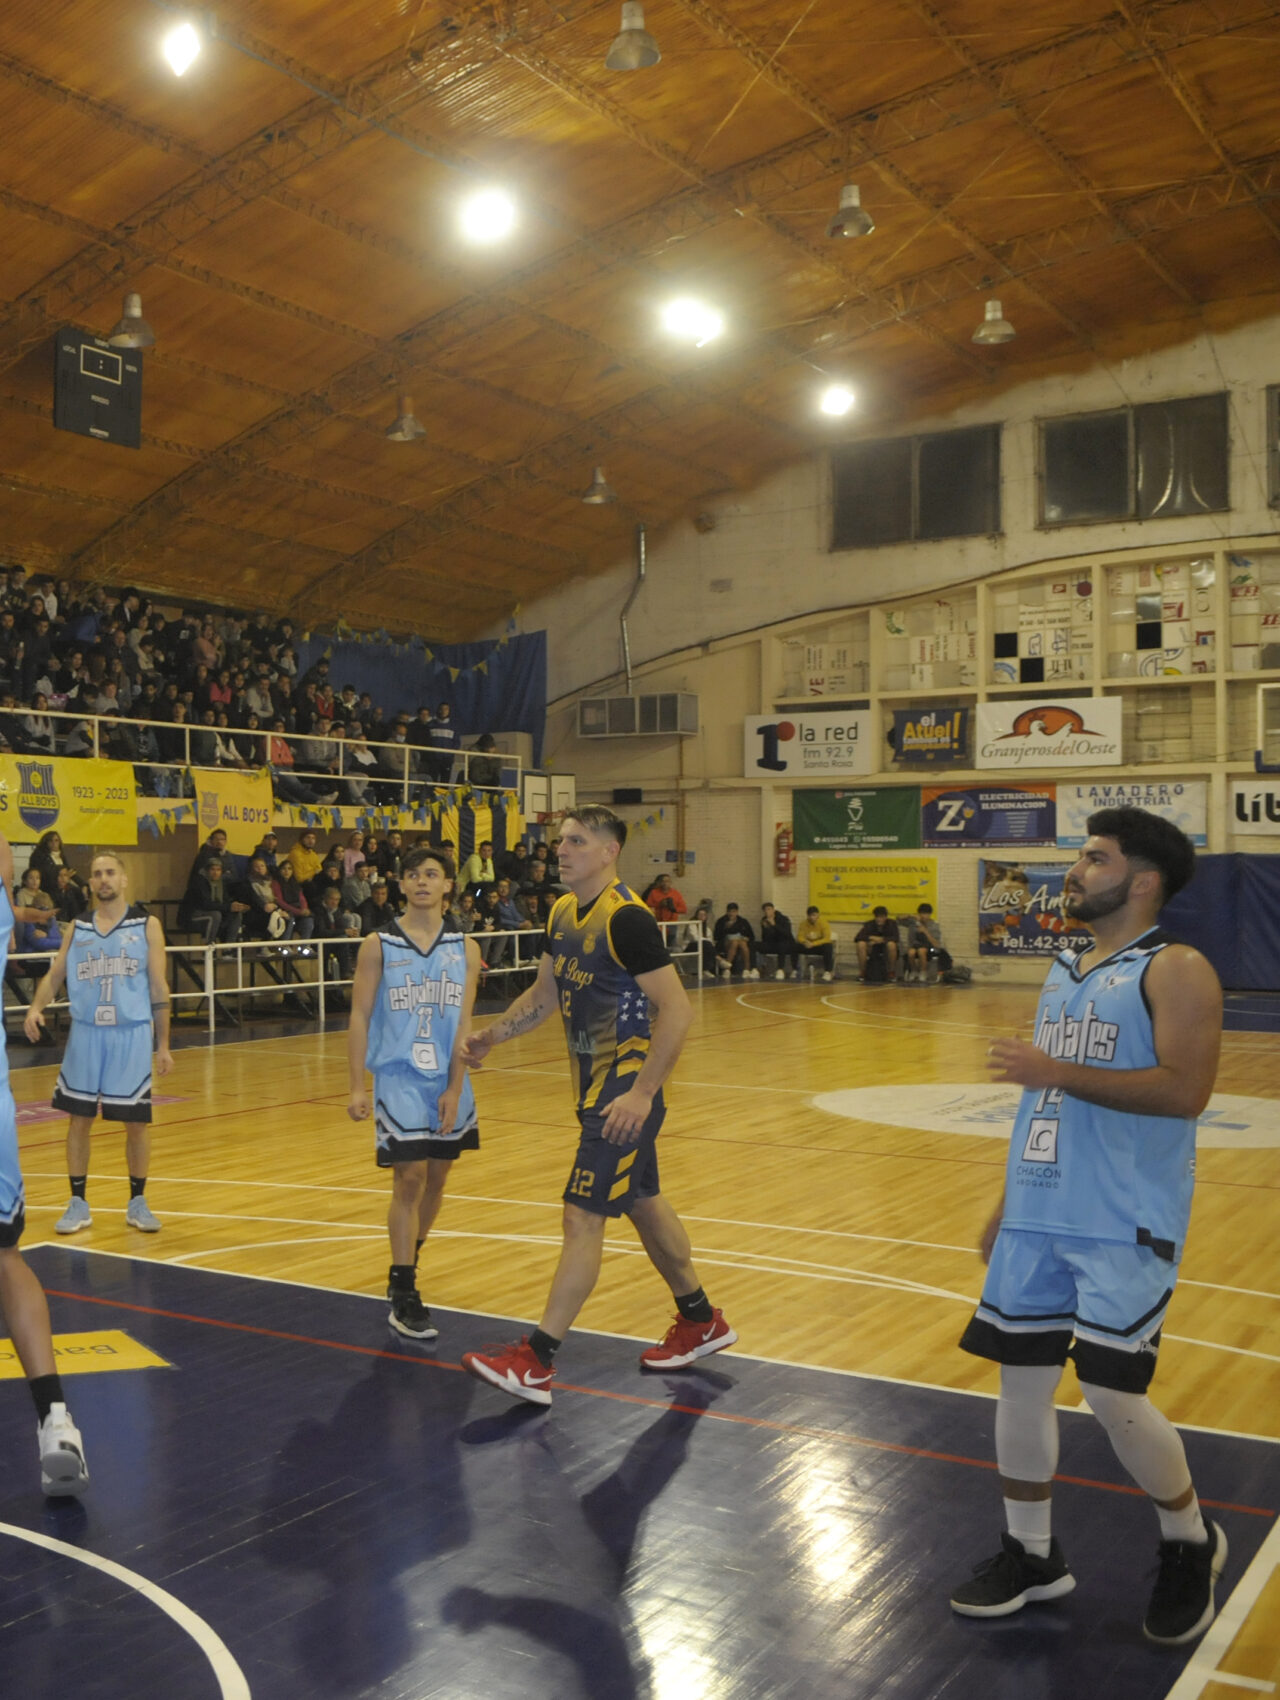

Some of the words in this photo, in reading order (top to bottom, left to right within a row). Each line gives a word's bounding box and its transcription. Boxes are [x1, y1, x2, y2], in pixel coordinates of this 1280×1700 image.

[920, 712, 936, 727] el
[799, 723, 816, 743] la
[825, 721, 859, 741] red
[803, 746, 821, 759] fm
[826, 745, 854, 759] 92.9
[803, 759, 829, 769] Santa
[832, 759, 854, 769] Rosa
[72, 786, 95, 799] 1923
[105, 787, 129, 800] 2023
[978, 792, 1050, 801] ELECTRICIDAD
[1076, 784, 1185, 798] LAVADERO
[21, 795, 36, 806] ALL
[36, 797, 57, 808] BOYS
[1093, 797, 1173, 808] INDUSTRIAL
[223, 805, 239, 821] ALL
[242, 807, 269, 824] BOYS
[936, 800, 966, 832] Z
[982, 881, 1024, 910] Los
[564, 956, 595, 992] Boys
[561, 989, 572, 1018] 12
[416, 1005, 434, 1040] 13
[1016, 1164, 1062, 1180] CHACÓN
[570, 1167, 596, 1198] 12
